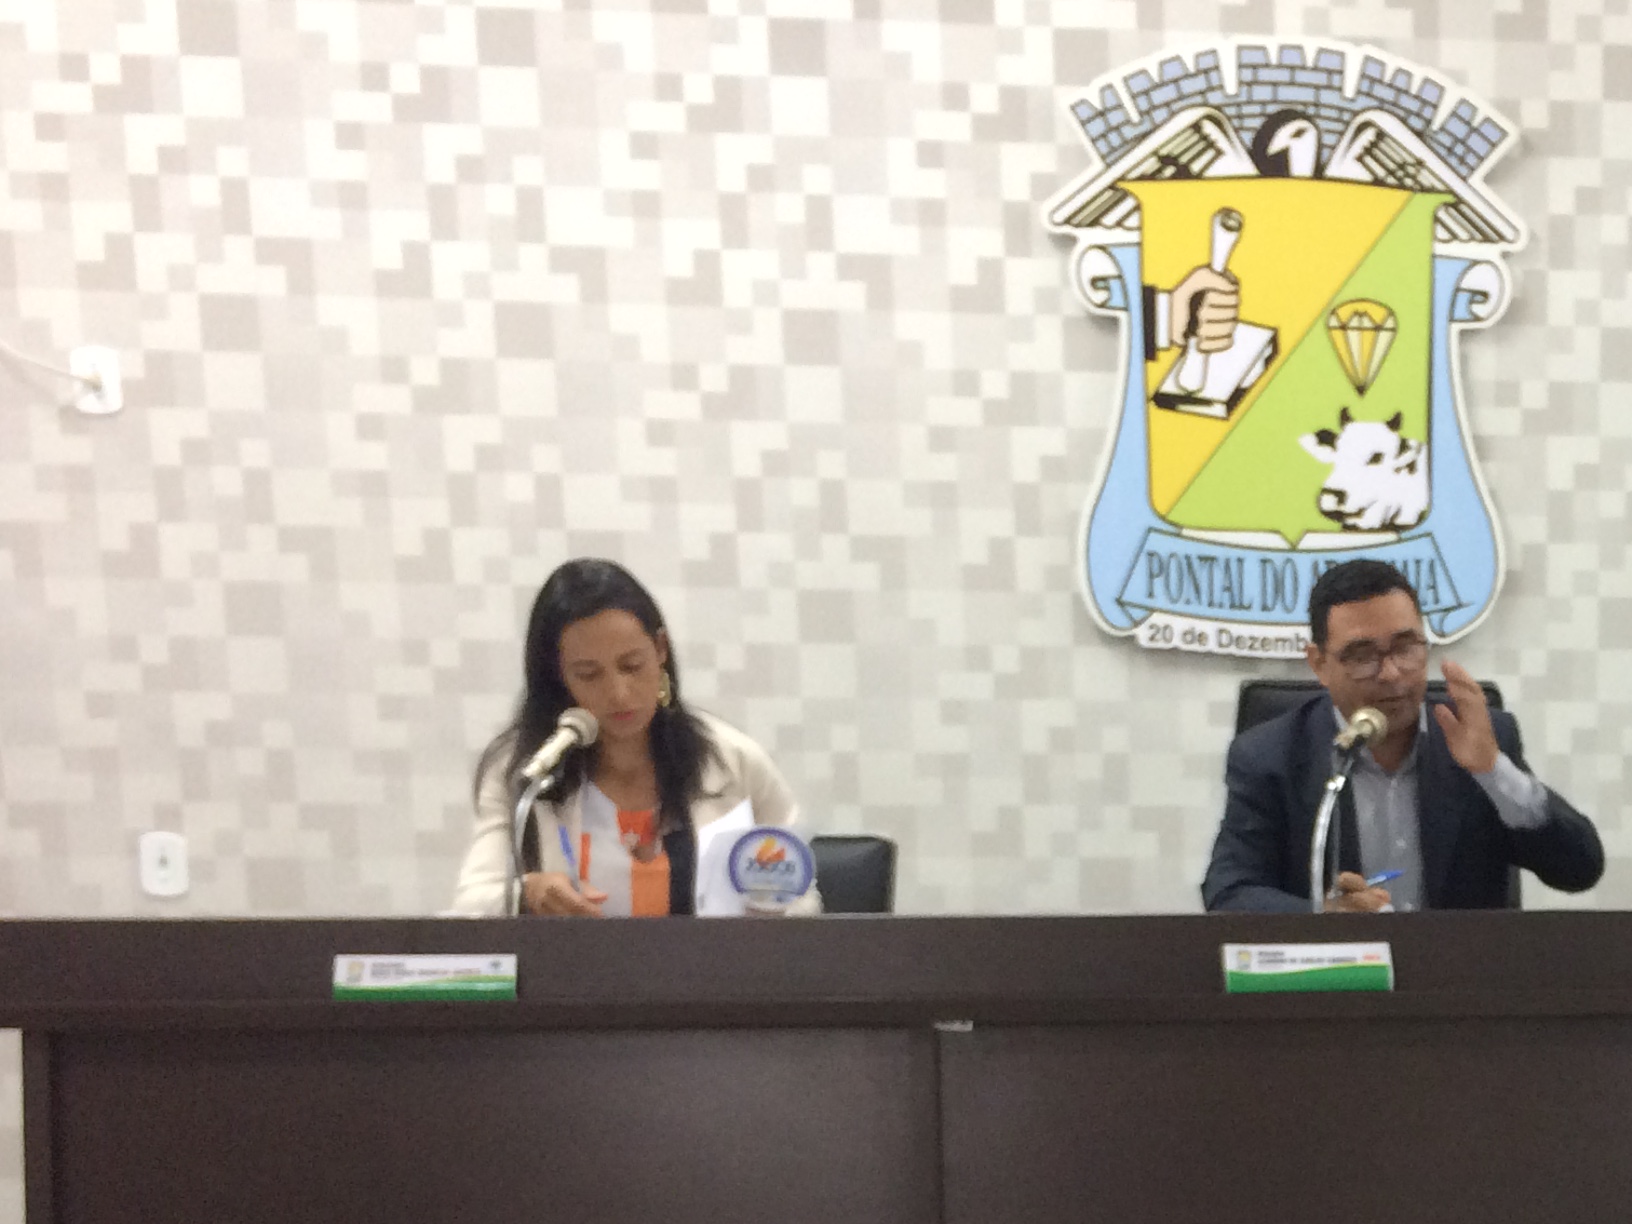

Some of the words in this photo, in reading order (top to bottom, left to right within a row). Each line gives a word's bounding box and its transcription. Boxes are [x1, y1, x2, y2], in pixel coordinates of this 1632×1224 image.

[1146, 551, 1253, 611] PONTAL
[1260, 557, 1299, 614] DO
[1148, 623, 1174, 644] 20
[1181, 627, 1208, 647] de
[1217, 629, 1308, 653] Dezemb
